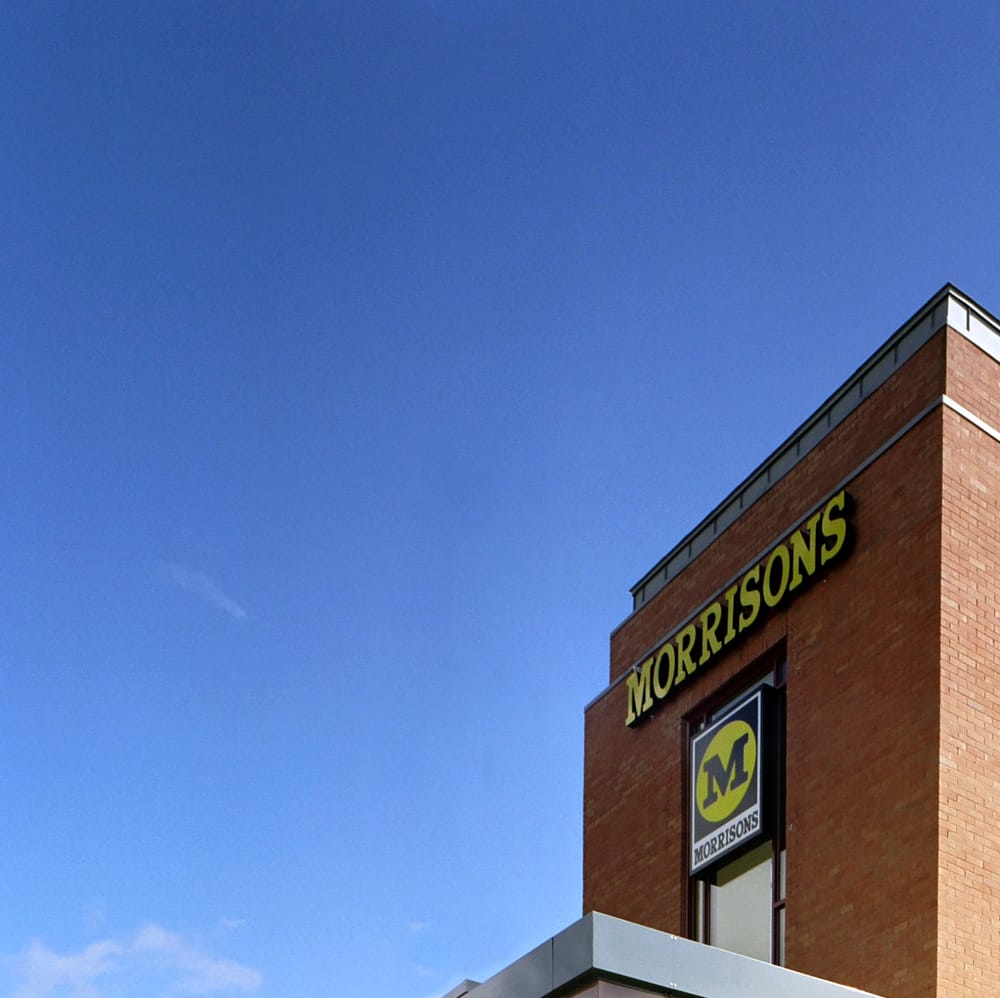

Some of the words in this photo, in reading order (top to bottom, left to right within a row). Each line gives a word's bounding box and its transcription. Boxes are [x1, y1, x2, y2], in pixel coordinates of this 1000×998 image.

[625, 490, 846, 727] MORRISONS
[703, 732, 749, 809] M
[694, 811, 759, 863] MORRISONS
